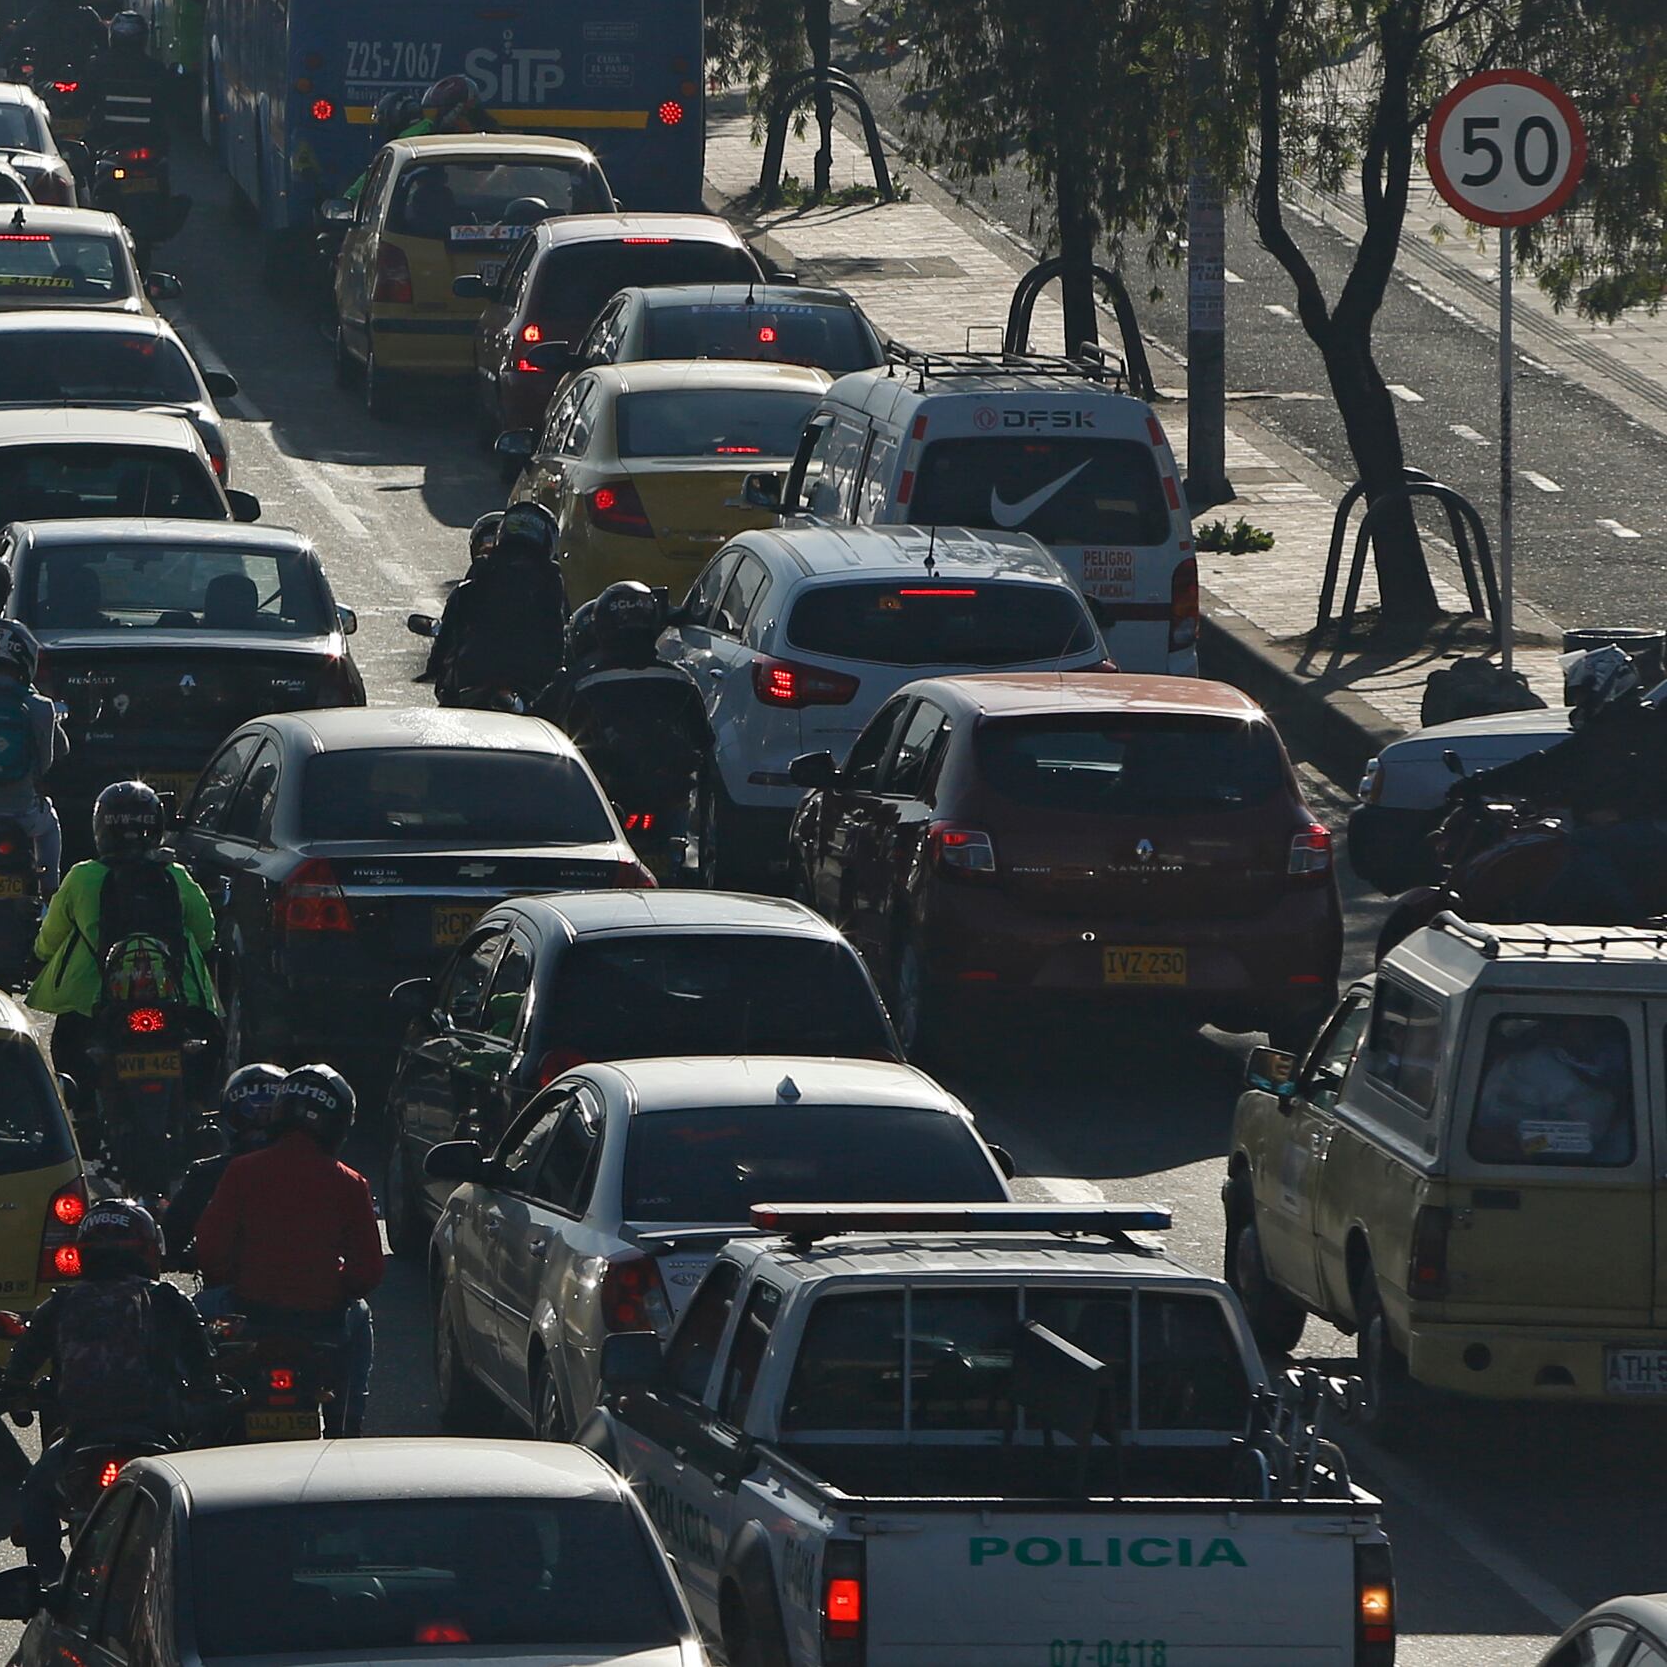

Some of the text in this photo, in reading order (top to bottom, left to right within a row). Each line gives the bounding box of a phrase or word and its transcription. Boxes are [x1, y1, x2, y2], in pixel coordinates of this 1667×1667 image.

[346, 41, 443, 81] Z25-7067
[465, 40, 566, 105] SiTP
[1461, 115, 1560, 186] 50
[1003, 413, 1094, 429] DFSK
[1083, 549, 1133, 567] PELIGRO
[67, 676, 117, 685] RENAULT
[1106, 863, 1184, 874] SANDERO
[646, 1479, 716, 1566] POLICIA
[969, 1537, 1249, 1567] POLICIA
[1049, 1638, 1168, 1667] 07-0418
